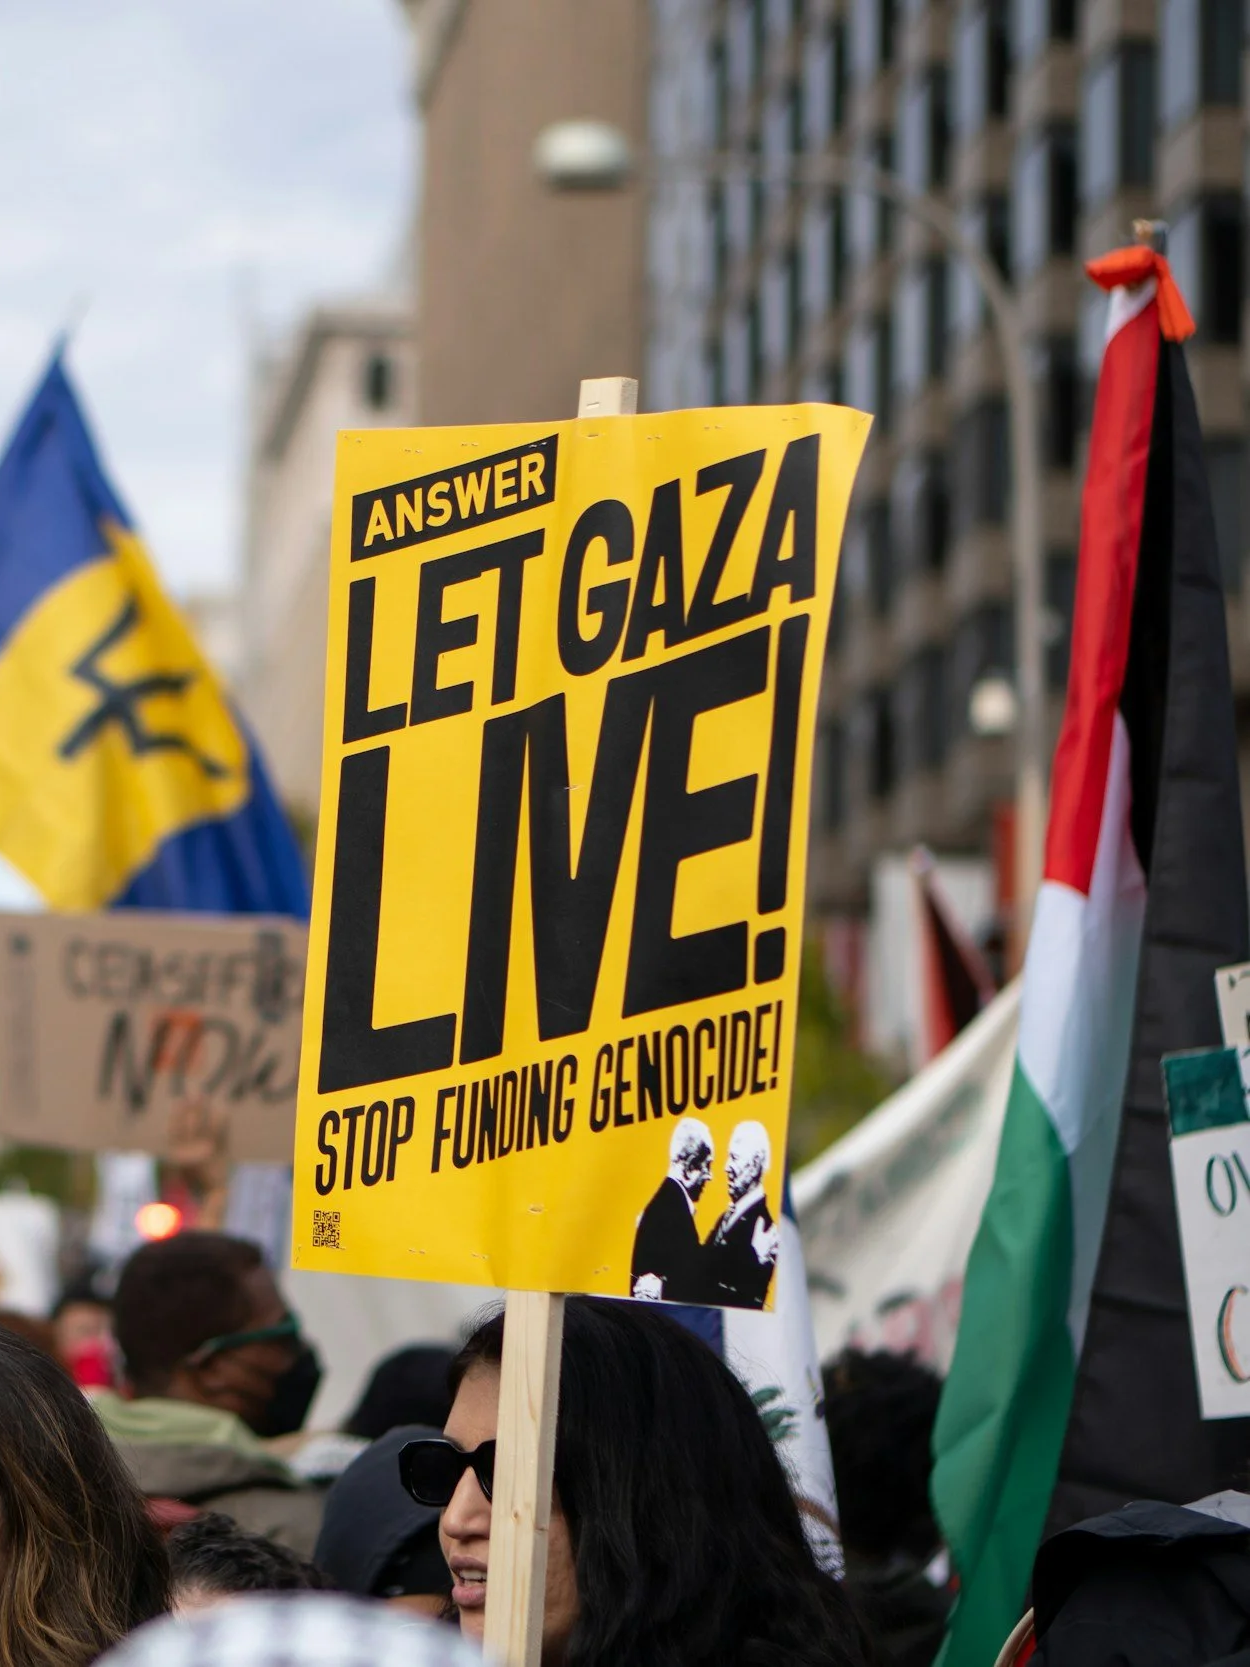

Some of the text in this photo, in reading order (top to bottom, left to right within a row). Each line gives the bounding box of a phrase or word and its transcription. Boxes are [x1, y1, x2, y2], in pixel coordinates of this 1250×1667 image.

[342, 432, 822, 745] LET GAZA
[362, 451, 547, 548] ANSWER
[317, 611, 811, 1096] LIVE!
[314, 999, 783, 1197] STOP FUNDING GENOCIDE!
